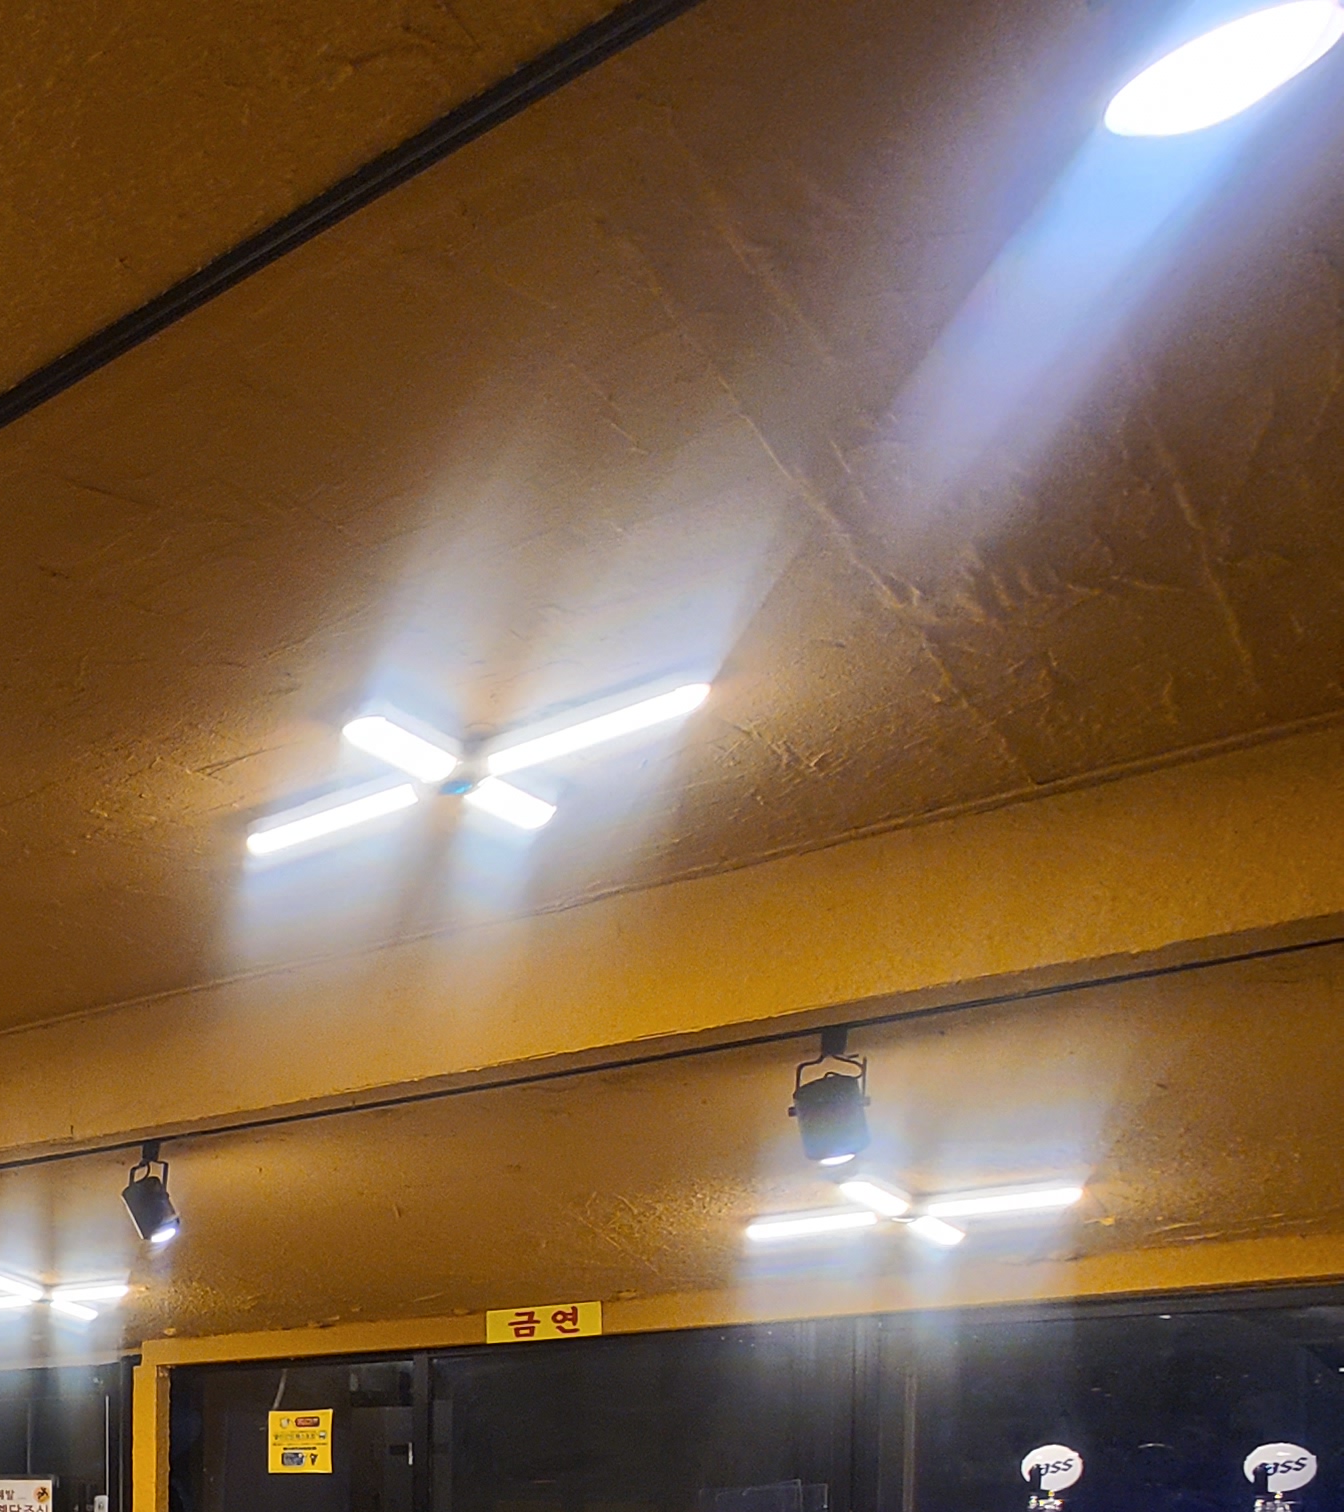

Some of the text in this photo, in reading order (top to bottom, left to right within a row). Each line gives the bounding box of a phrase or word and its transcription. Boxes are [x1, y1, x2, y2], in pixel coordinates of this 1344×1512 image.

[508, 1306, 580, 1338] 금연
[1034, 1458, 1074, 1477] ass
[1252, 1457, 1308, 1476] ass
